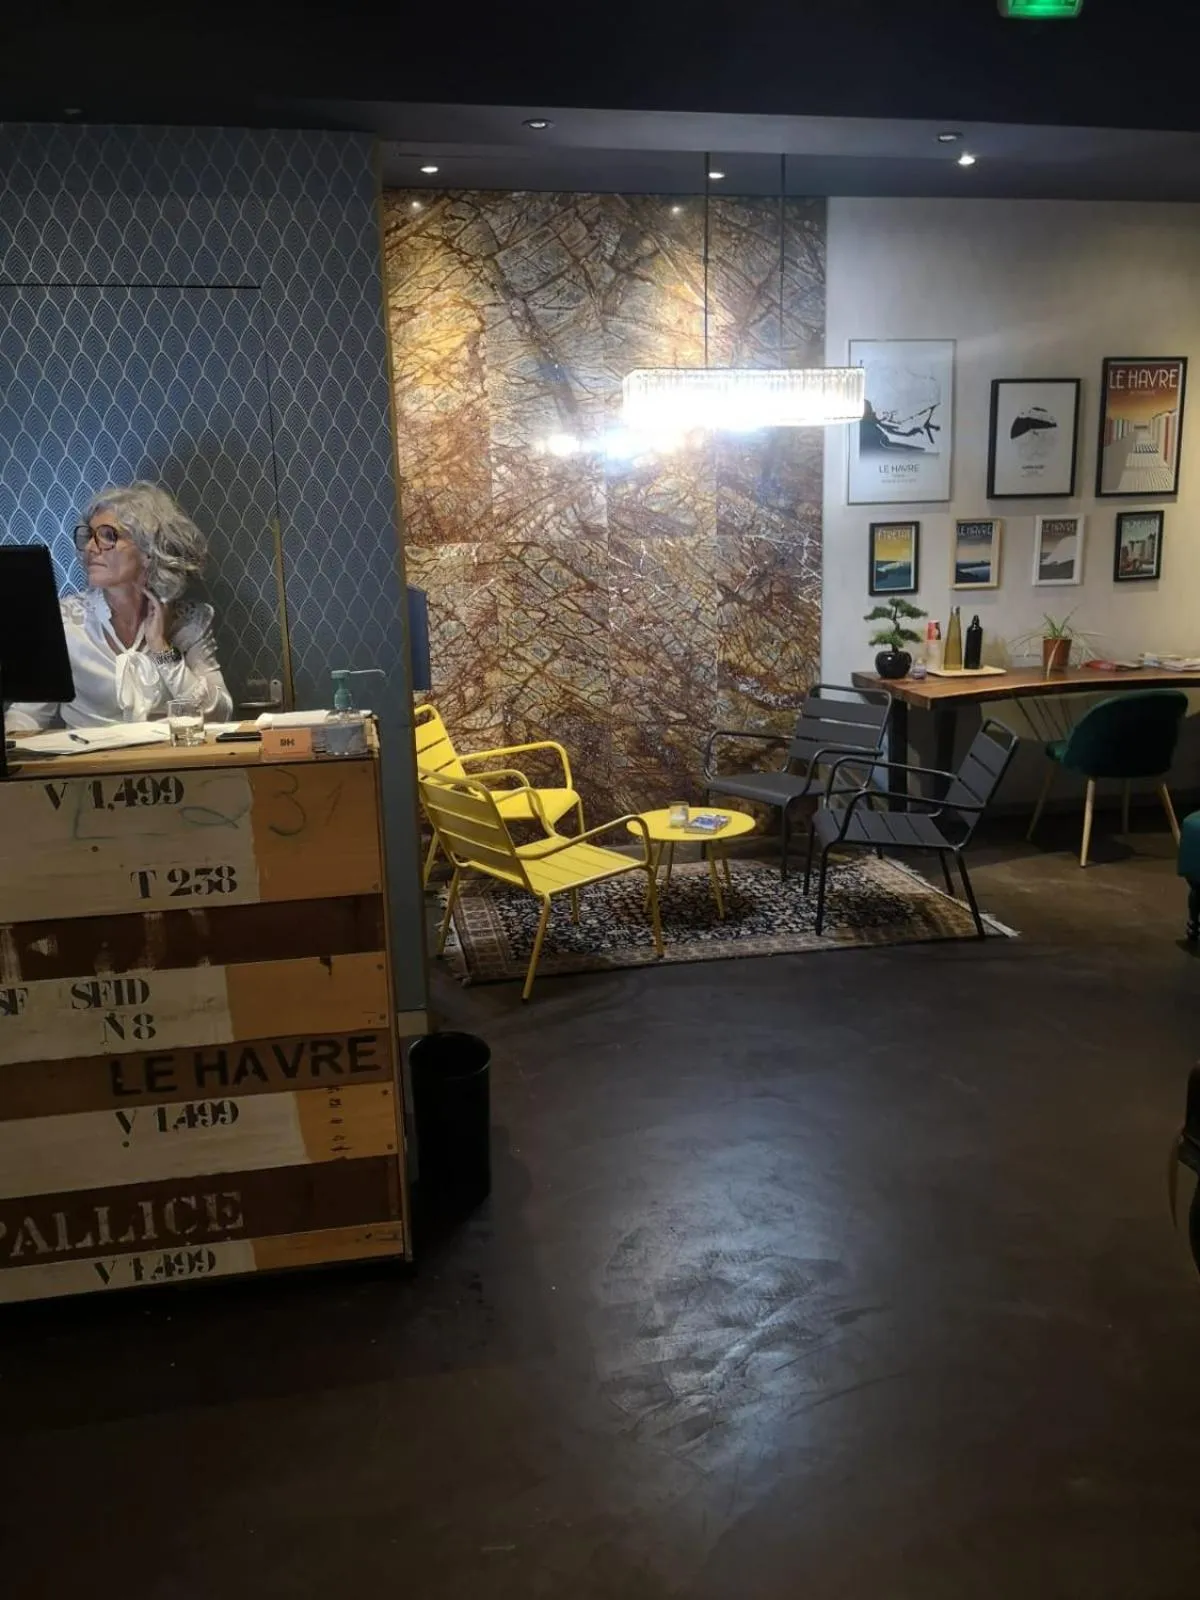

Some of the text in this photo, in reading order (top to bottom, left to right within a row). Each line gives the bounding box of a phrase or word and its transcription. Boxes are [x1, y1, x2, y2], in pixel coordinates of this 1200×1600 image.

[1109, 368, 1178, 389] LE HAVRE
[878, 463, 921, 474] LE HAVRE
[44, 782, 69, 810] V
[128, 868, 157, 899] T
[111, 1035, 382, 1096] LE HAVRE
[115, 1109, 137, 1135] V
[0, 1190, 245, 1257] ALLICE
[94, 1259, 117, 1285] V
